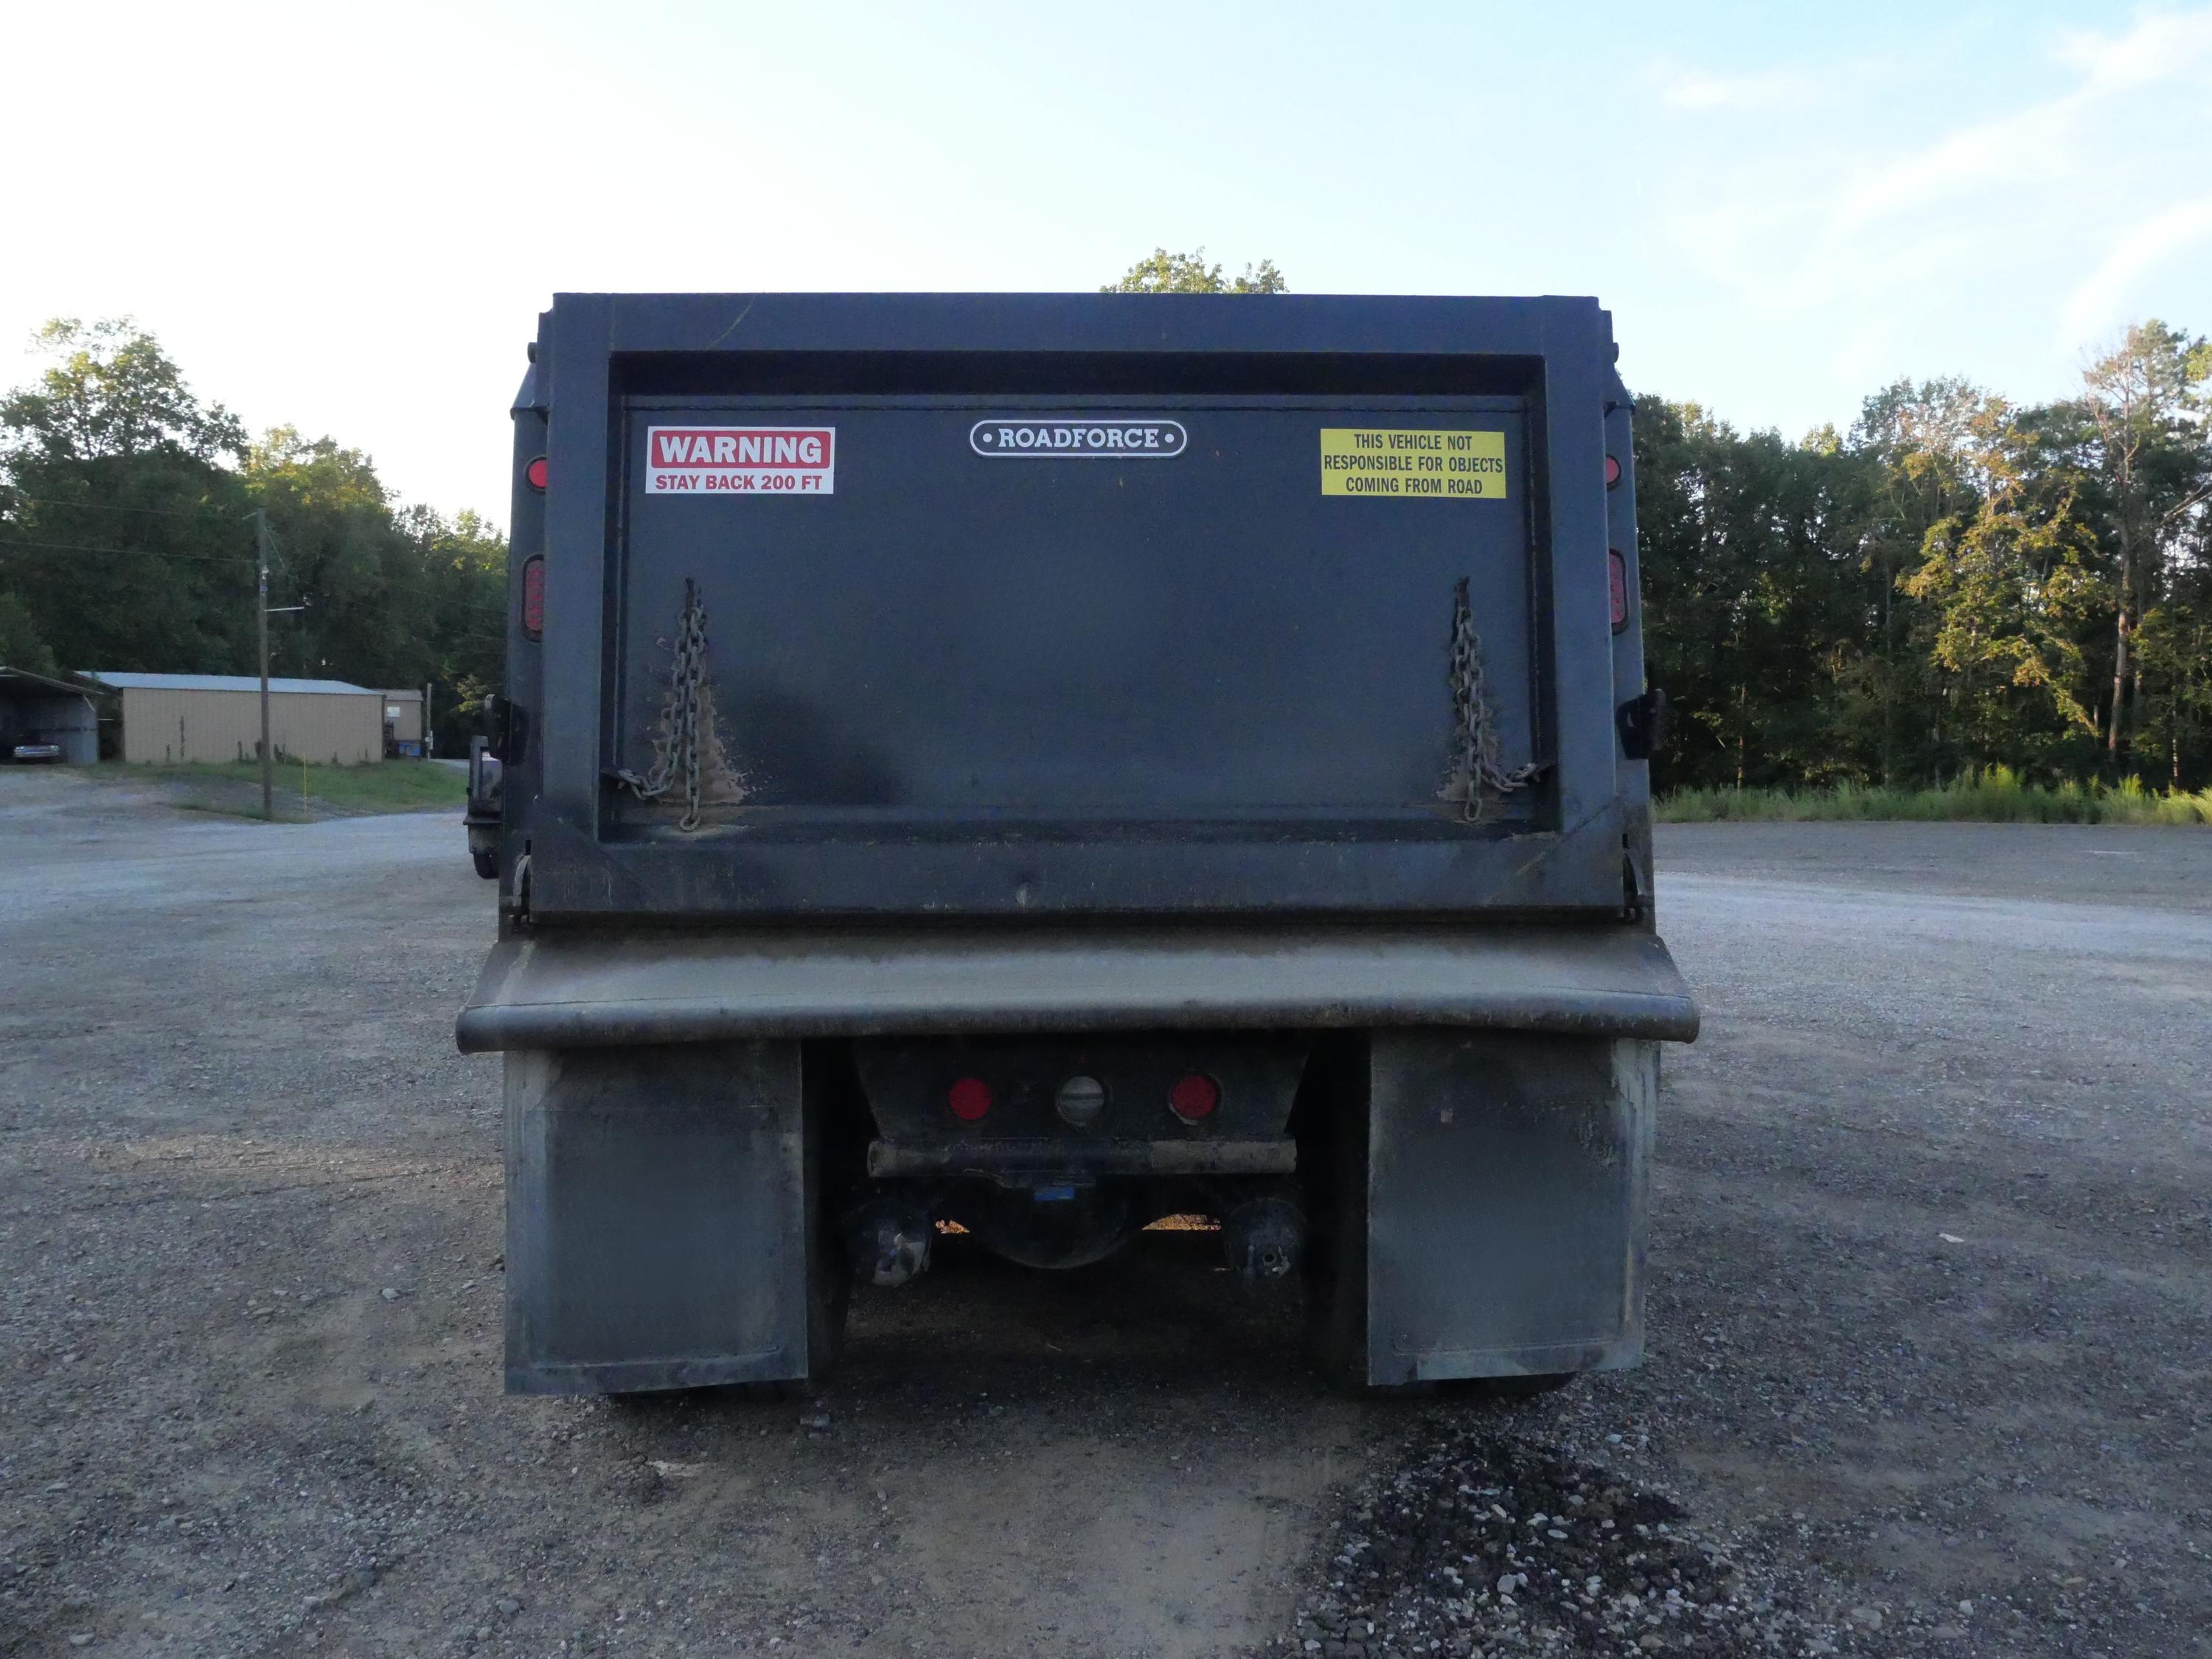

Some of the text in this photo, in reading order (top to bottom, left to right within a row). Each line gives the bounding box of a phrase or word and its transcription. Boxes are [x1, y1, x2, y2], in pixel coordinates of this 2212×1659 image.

[998, 428, 1159, 448] ROADFORCE
[1354, 434, 1472, 451] THIS VEHICLE NOT
[659, 436, 821, 463] WARNING
[1324, 455, 1503, 473] RESPONSIBLE FOR OBJECTS
[655, 475, 822, 490] STAY BACK 200 FT
[1346, 477, 1483, 494] COMING FROM ROAD
